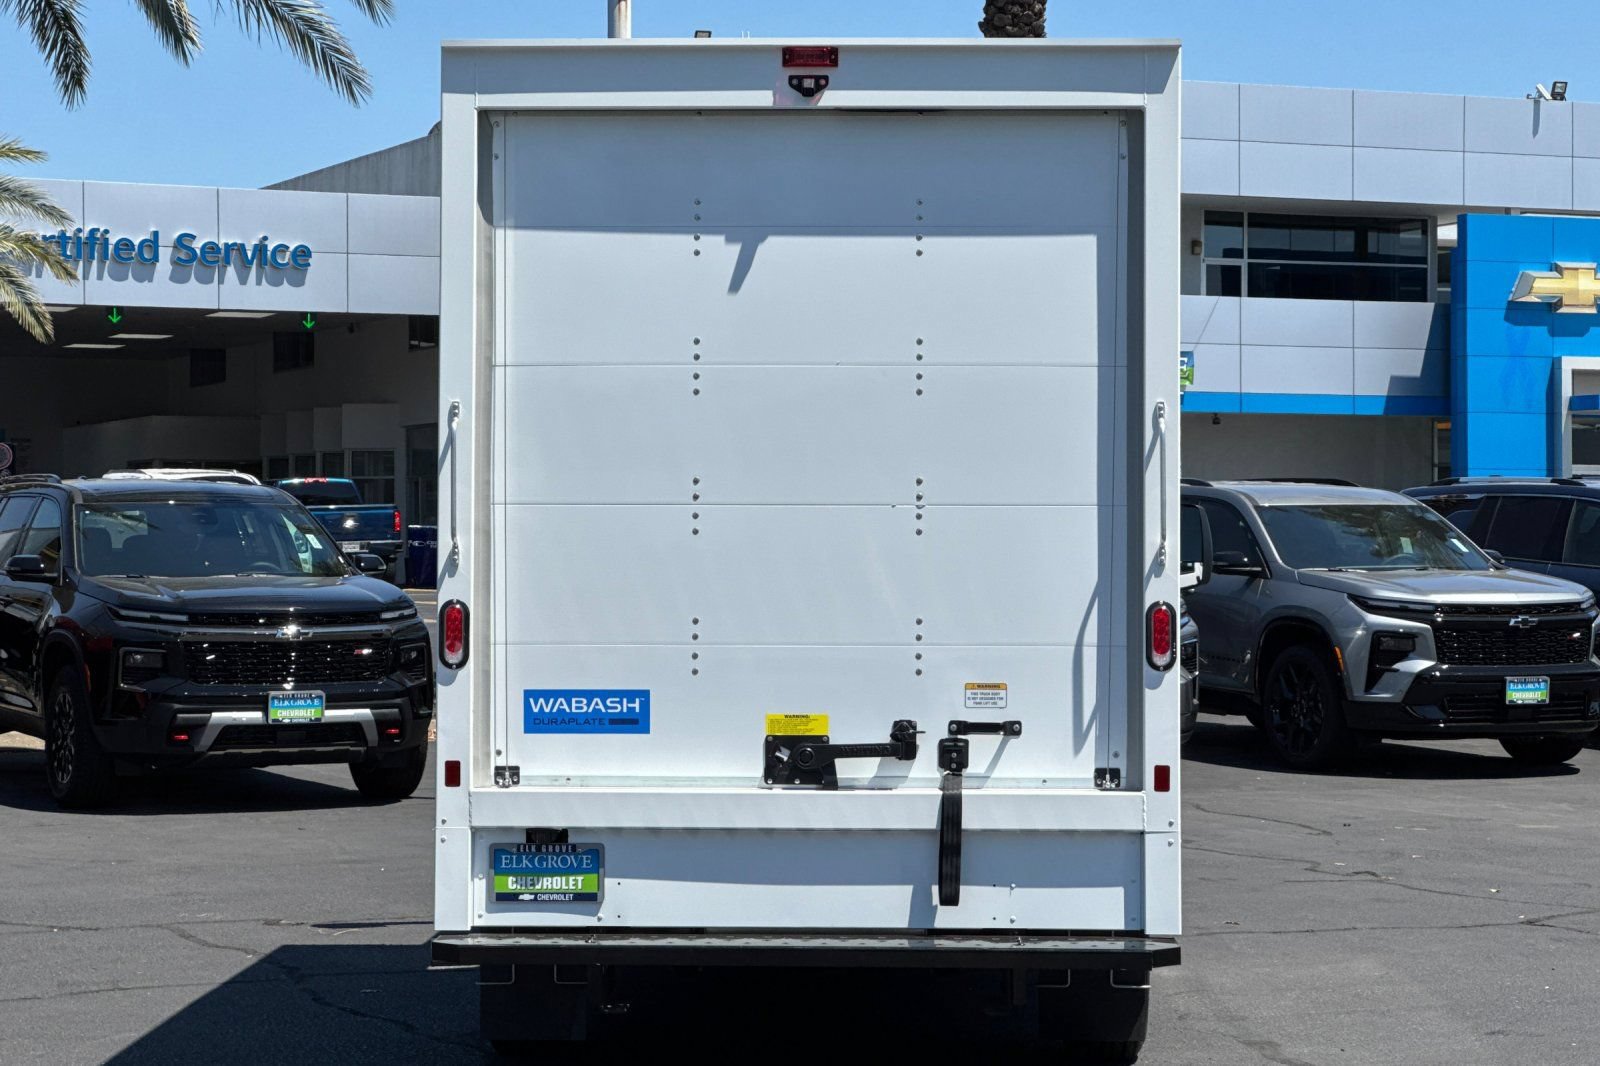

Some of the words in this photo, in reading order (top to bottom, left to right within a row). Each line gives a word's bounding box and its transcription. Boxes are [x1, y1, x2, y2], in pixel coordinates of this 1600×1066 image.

[175, 232, 313, 269] Service
[290, 698, 320, 706] GROVE
[277, 709, 315, 717] CHEVROLET
[533, 717, 606, 726] DURAPLATE
[520, 844, 538, 853] ELK
[541, 844, 573, 853] GROVE
[500, 855, 534, 869] ELK
[534, 855, 593, 869] GROVE
[508, 876, 585, 890] CHEVROLET
[537, 893, 574, 901] CHEVROLET
